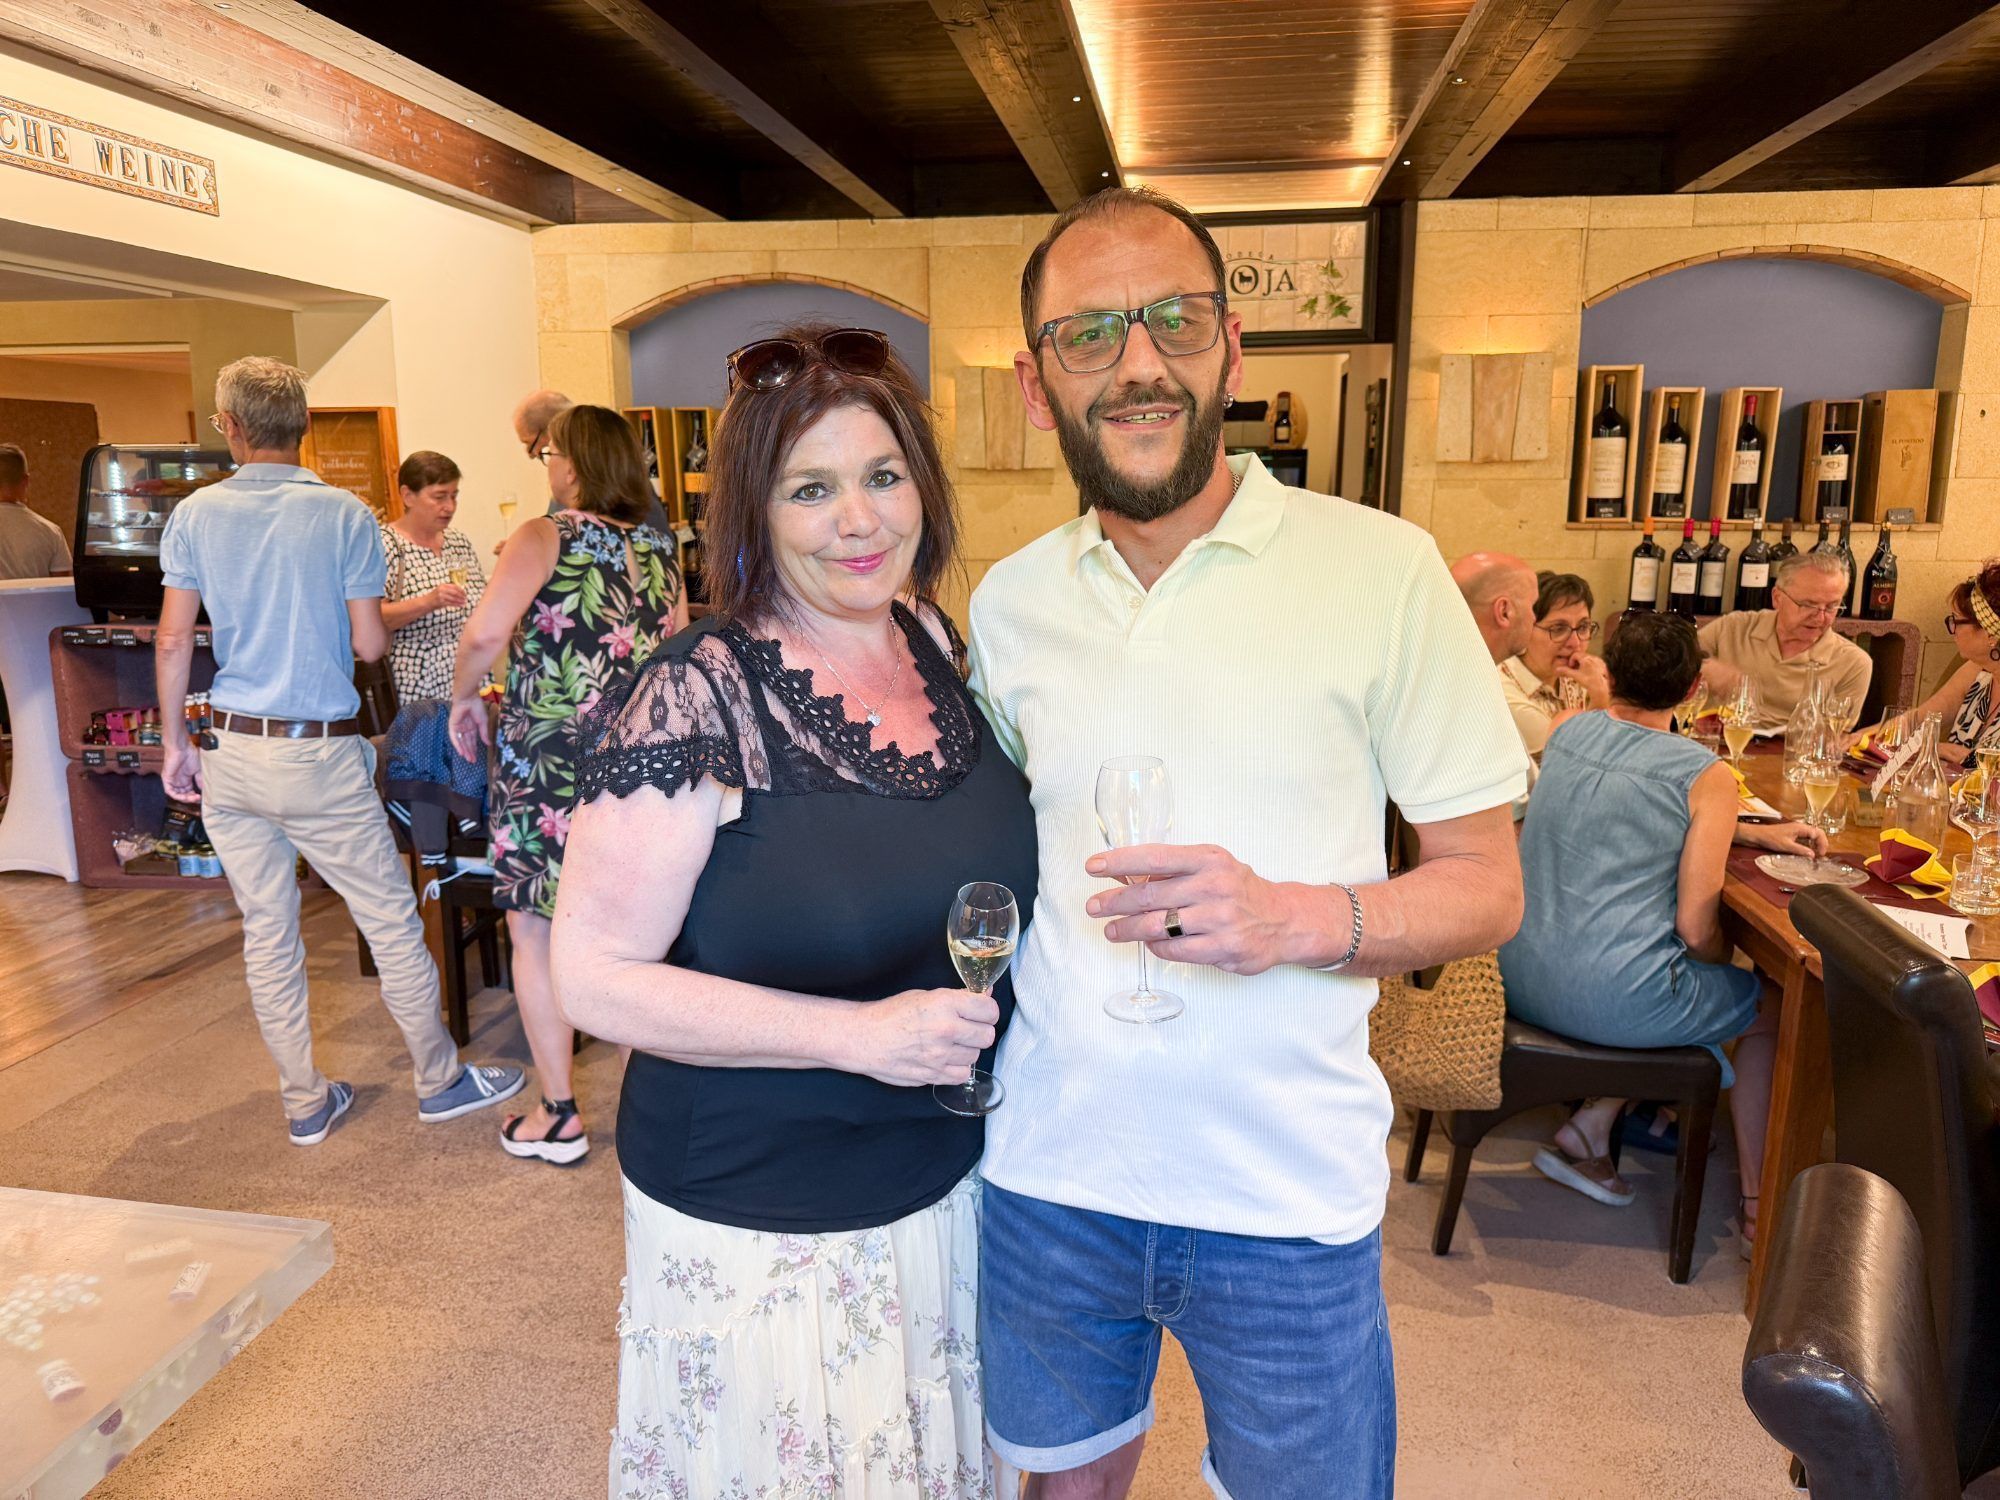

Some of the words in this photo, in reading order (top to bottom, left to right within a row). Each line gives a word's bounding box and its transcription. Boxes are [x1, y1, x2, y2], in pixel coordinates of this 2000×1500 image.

[0, 110, 69, 164] CHE
[94, 138, 198, 198] WEINE
[1226, 251, 1274, 260] ODEGA
[1230, 264, 1297, 296] OJA
